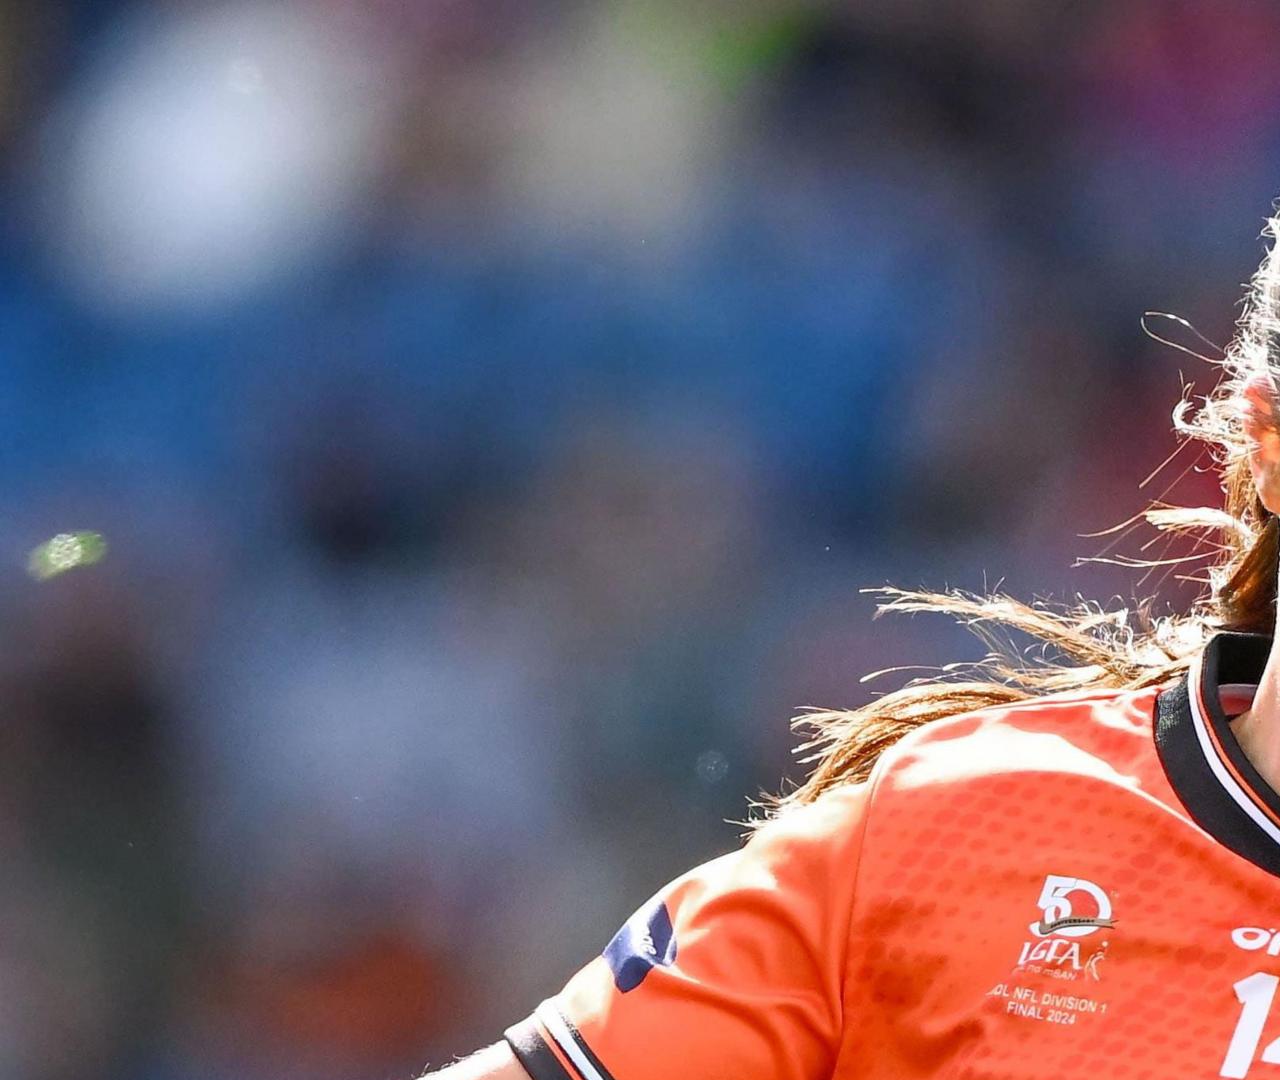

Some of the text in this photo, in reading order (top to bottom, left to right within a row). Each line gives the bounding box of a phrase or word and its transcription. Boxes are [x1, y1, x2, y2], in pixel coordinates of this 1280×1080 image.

[1029, 875, 1112, 937] 50
[1007, 1001, 1077, 1025] FINAL 2024
[1013, 986, 1039, 1004] NFL
[1041, 993, 1098, 1014] DIVISION
